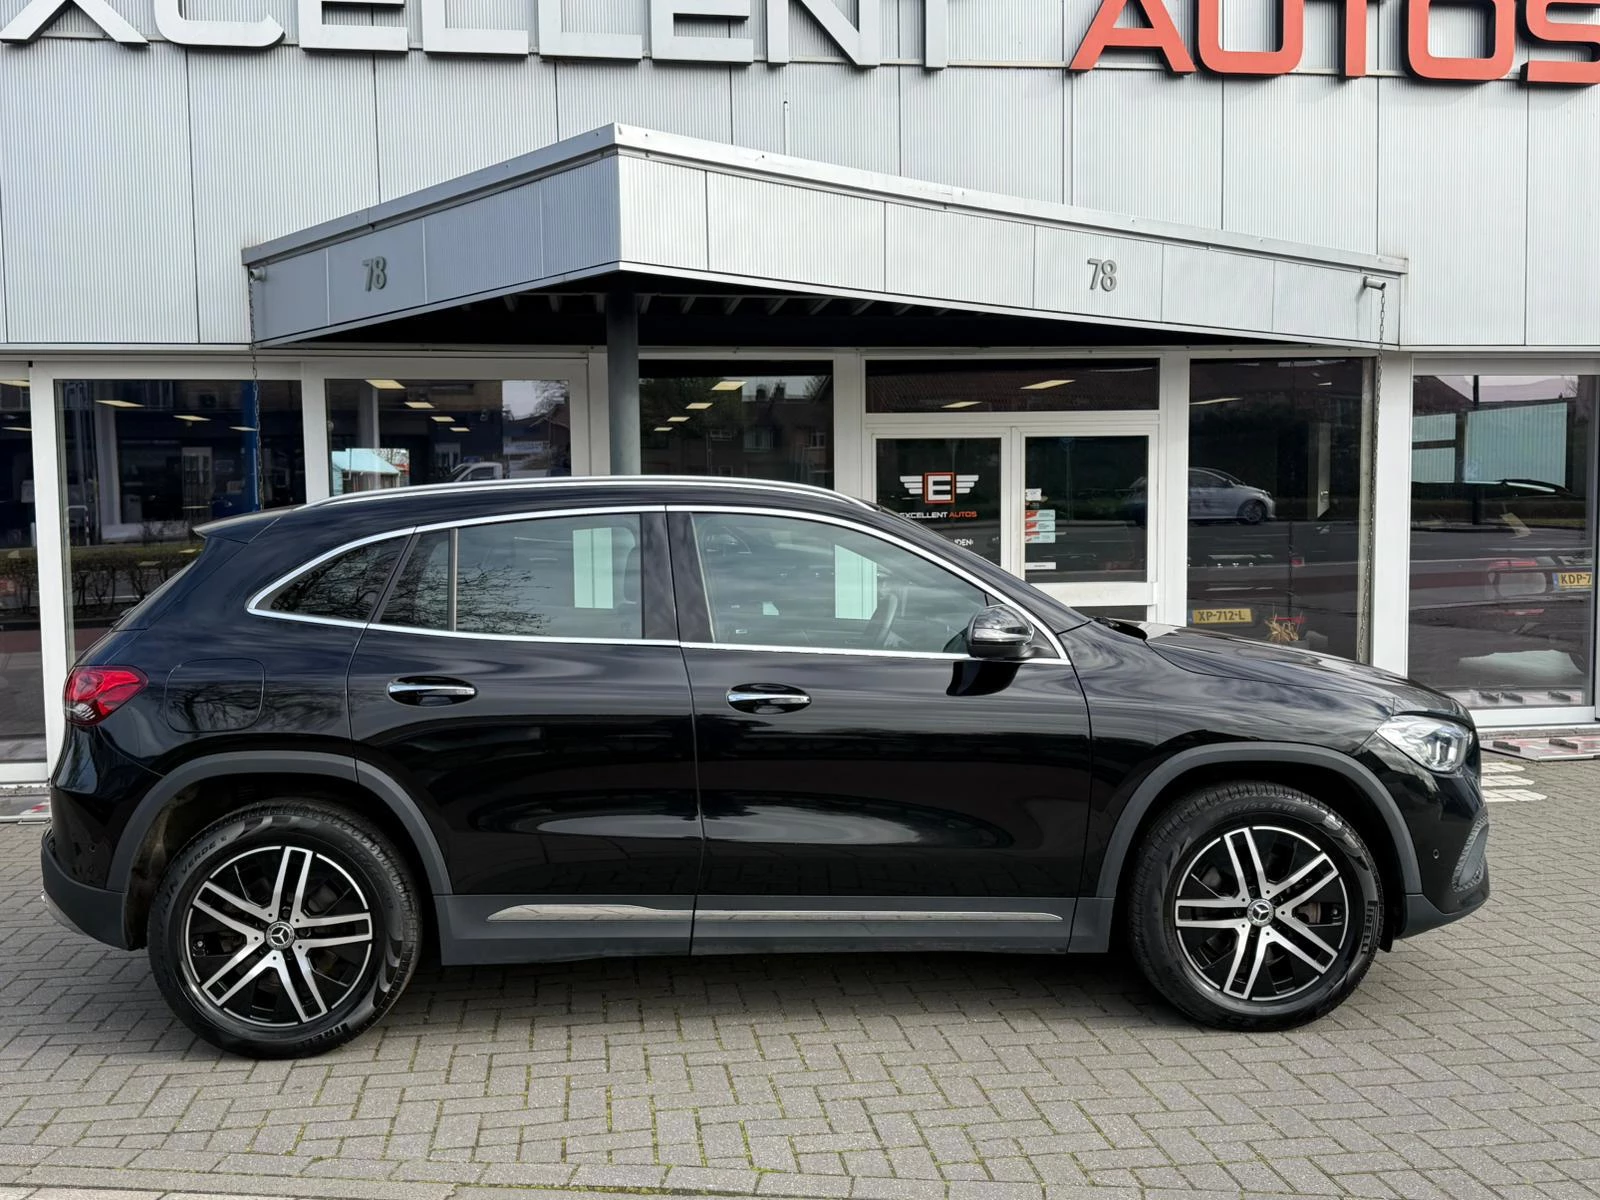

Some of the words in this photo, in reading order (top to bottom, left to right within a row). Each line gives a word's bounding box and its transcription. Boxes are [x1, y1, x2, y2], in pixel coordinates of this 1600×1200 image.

[1067, 0, 1600, 85] AUTOS
[361, 256, 387, 292] 78
[1087, 258, 1117, 292] 78
[948, 510, 978, 518] AUTOS
[1198, 610, 1246, 622] XP-712-L
[181, 840, 217, 874] VERDE
